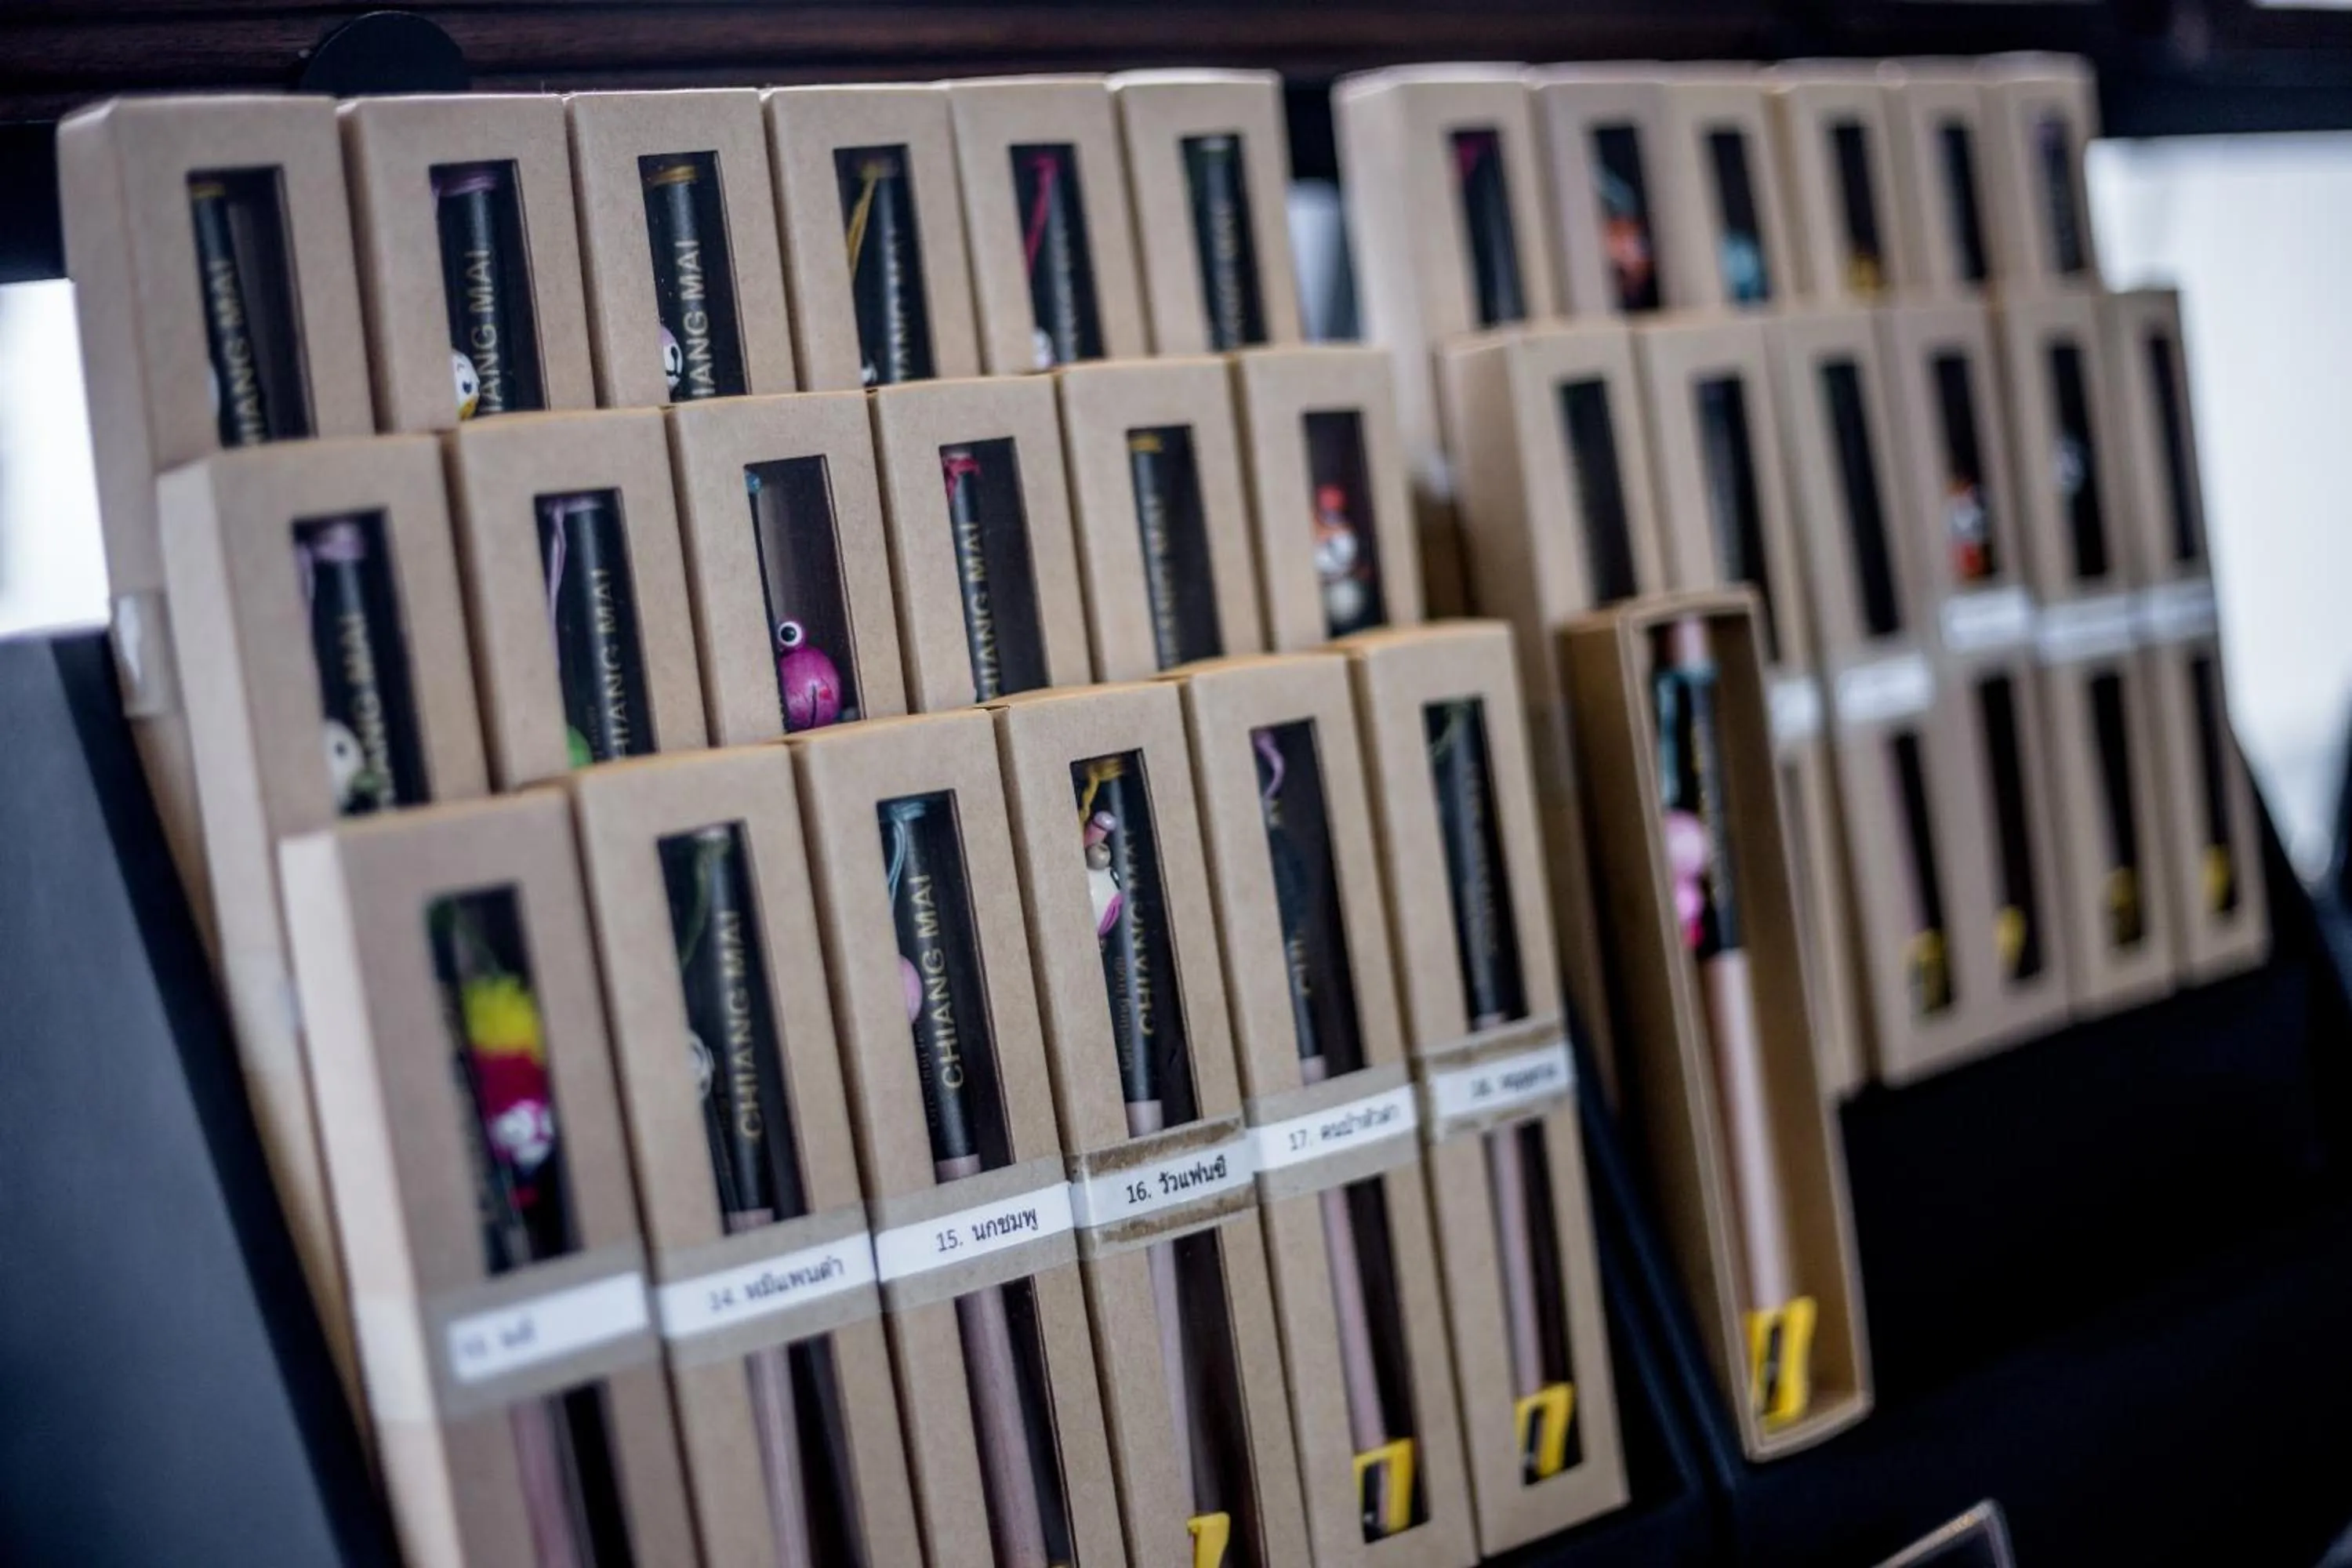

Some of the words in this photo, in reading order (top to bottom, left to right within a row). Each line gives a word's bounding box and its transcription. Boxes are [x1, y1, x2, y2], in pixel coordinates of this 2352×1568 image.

[210, 260, 242, 329] MAI
[466, 251, 495, 313] MAI
[677, 241, 704, 300] MAI
[472, 325, 503, 413] IANG
[686, 312, 714, 396] IANG
[960, 521, 986, 583] MAI
[591, 568, 617, 635] MAI
[599, 645, 631, 759] HIANG
[909, 873, 939, 937] MAI
[717, 909, 743, 979] MAI
[923, 948, 963, 1089] CHIANG
[726, 988, 761, 1140] CHIANG
[1126, 1181, 1152, 1204] 16.
[935, 1229, 964, 1252] 15.
[971, 1208, 1039, 1241] นกชมพู
